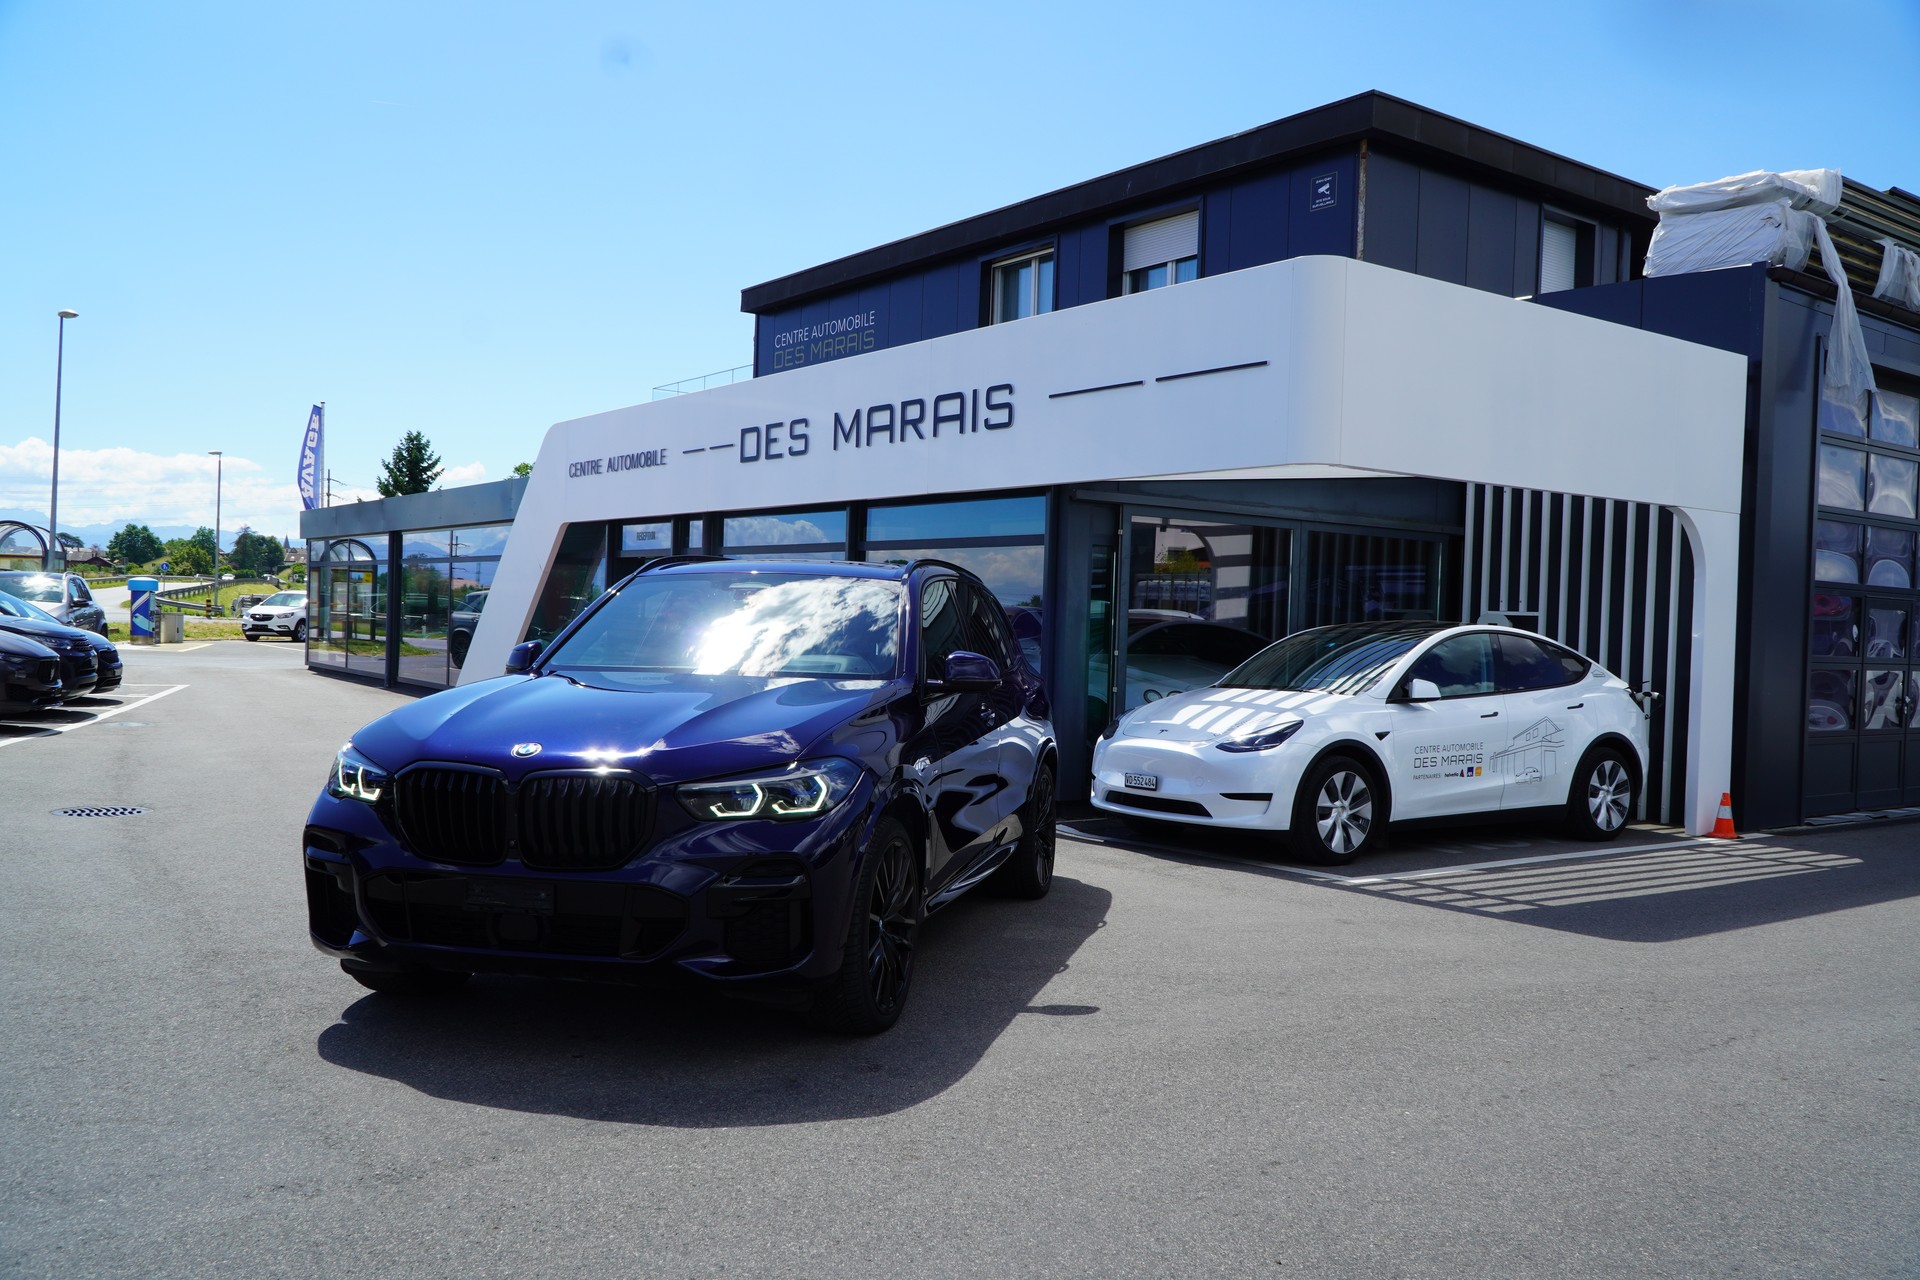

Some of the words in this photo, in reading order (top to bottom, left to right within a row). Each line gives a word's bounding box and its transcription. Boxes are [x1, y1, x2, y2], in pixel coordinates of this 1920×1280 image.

[774, 327, 809, 348] CENTRE
[811, 311, 876, 339] AUTOMOBILE
[774, 345, 805, 369] DES
[810, 329, 875, 360] MARAIS
[569, 458, 602, 478] CENTRE
[606, 448, 667, 473] AUTOMOBILE
[740, 418, 809, 463] DES
[833, 383, 1014, 450] MARAIS
[1414, 757, 1437, 768] DES
[1441, 754, 1483, 766] MARAIS
[1415, 745, 1440, 754] CENTRE
[1442, 742, 1483, 752] AUTOMOBILE
